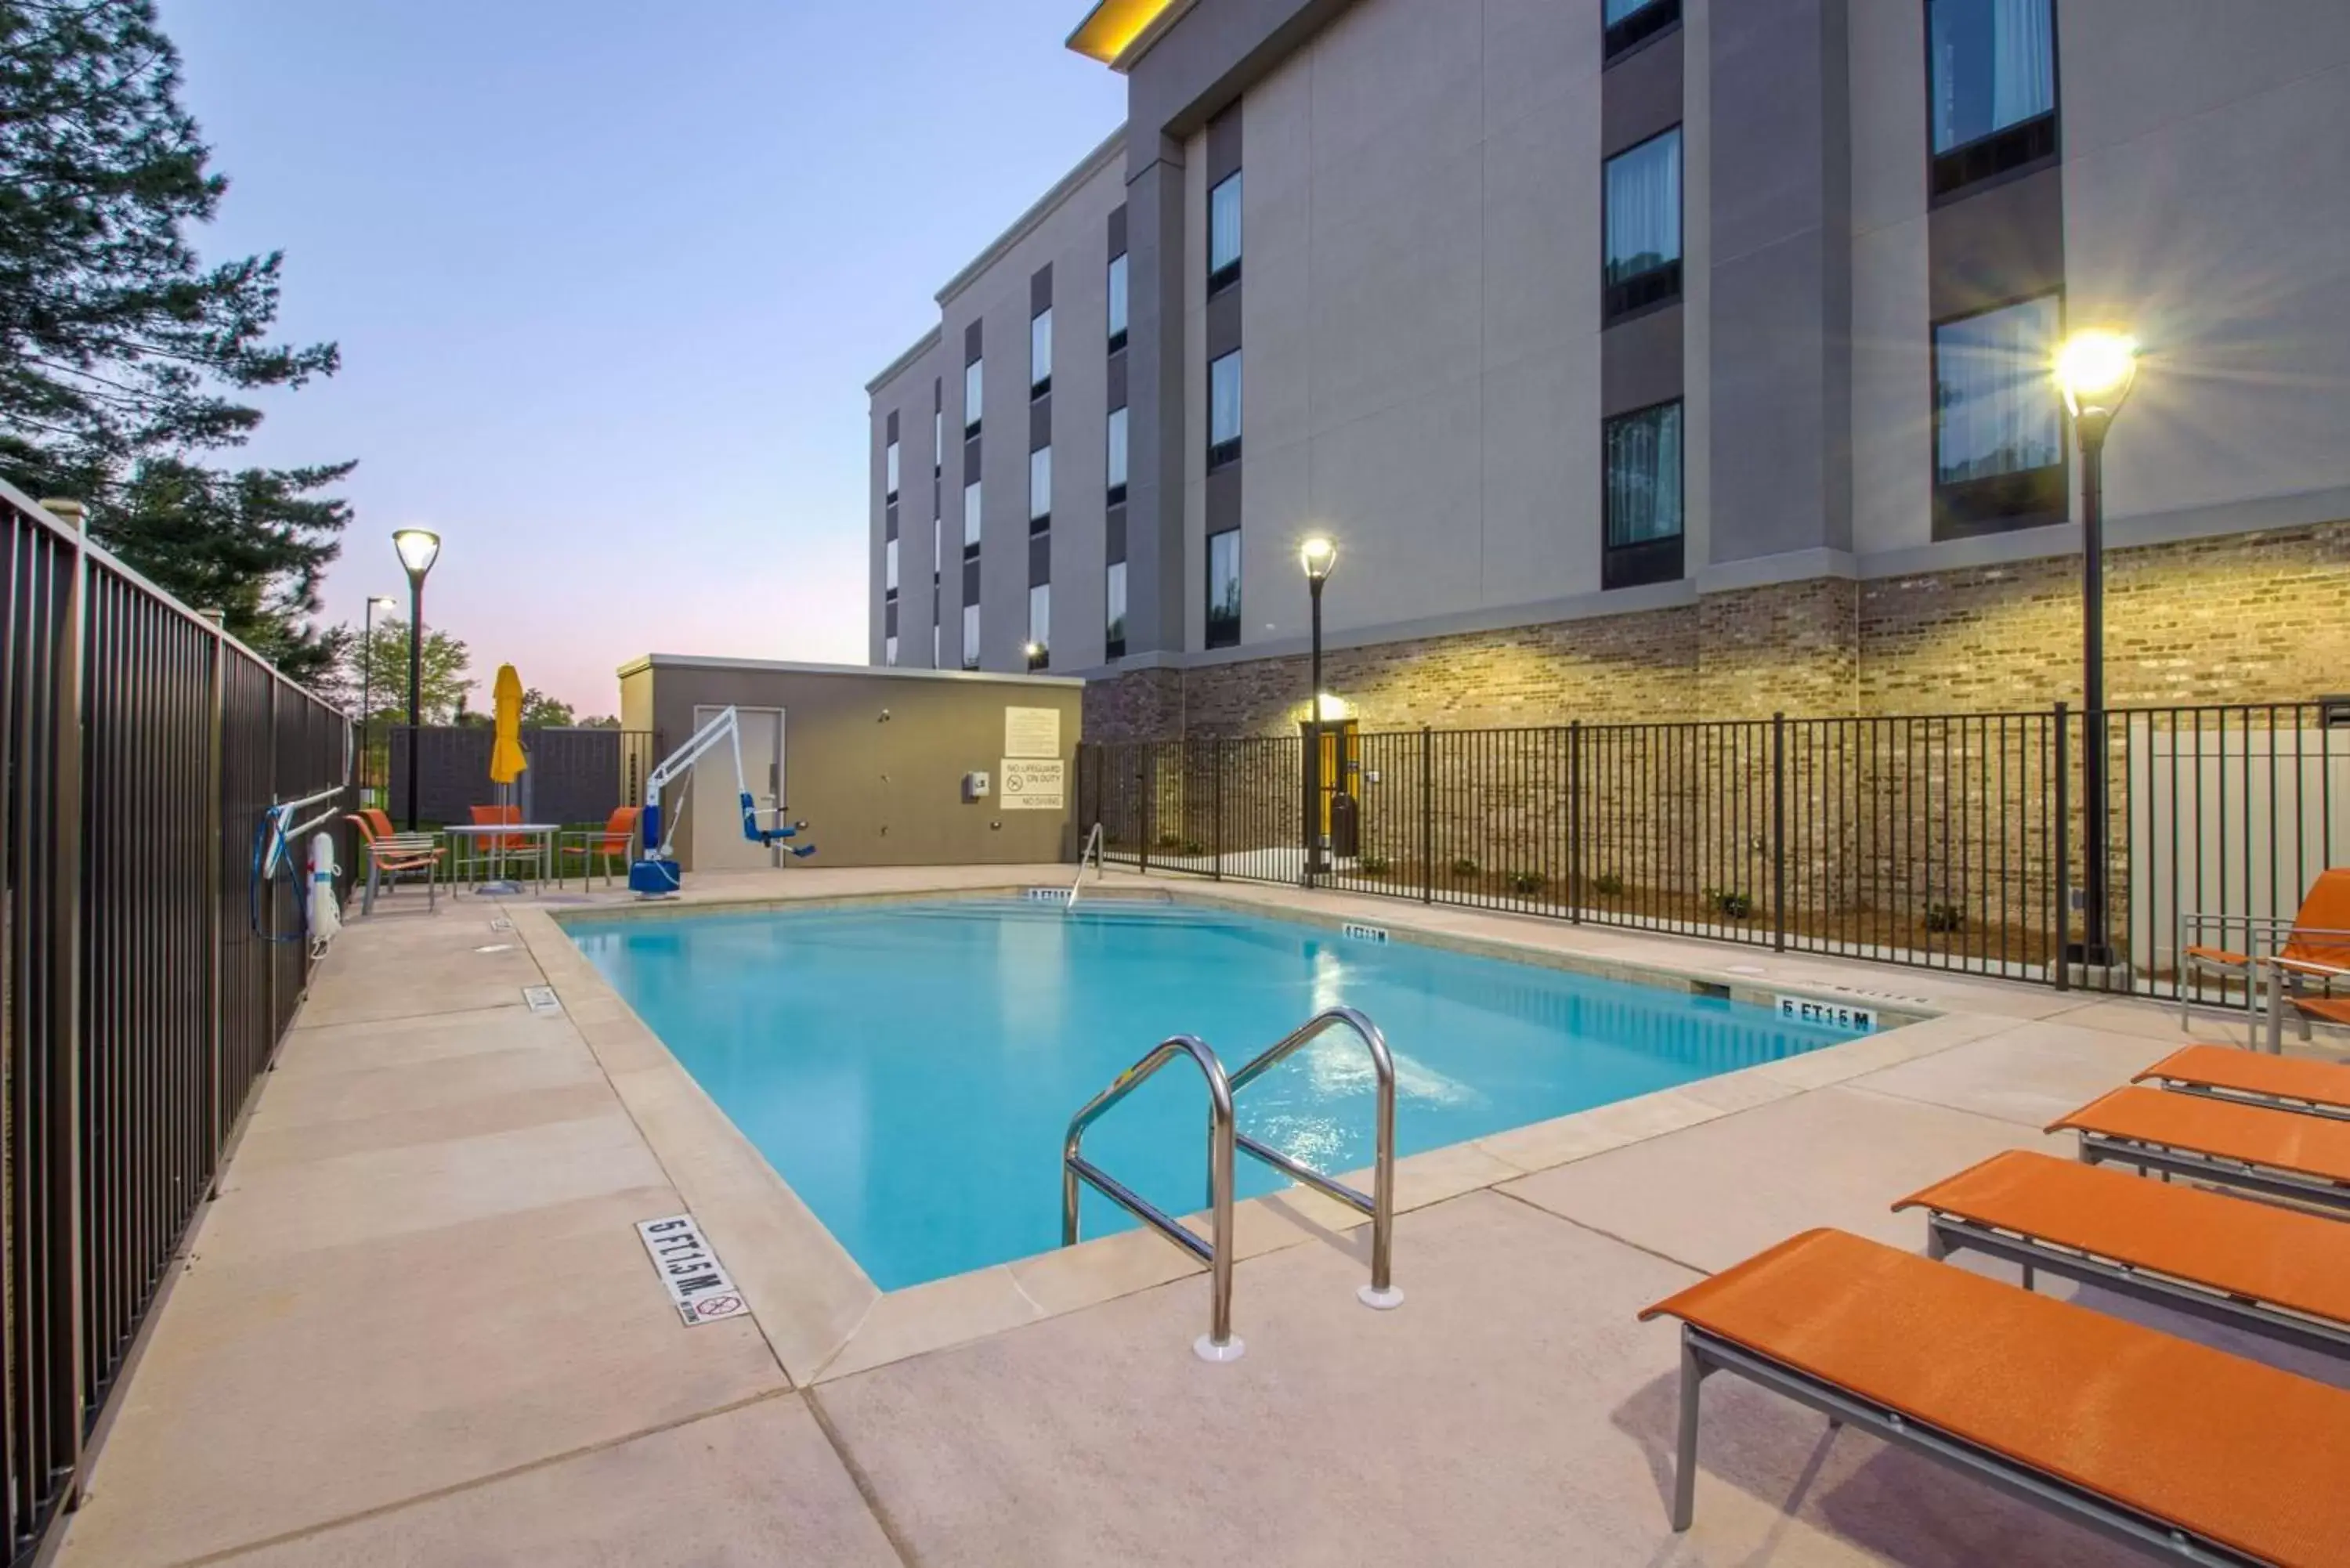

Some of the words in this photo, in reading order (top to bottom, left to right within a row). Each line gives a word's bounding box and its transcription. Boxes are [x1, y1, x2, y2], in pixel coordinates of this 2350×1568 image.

[1007, 764, 1019, 773] NO
[1026, 775, 1038, 783] ON
[1040, 775, 1061, 783] DUTY
[1783, 999, 1793, 1017] 5
[648, 1219, 687, 1233] 5
